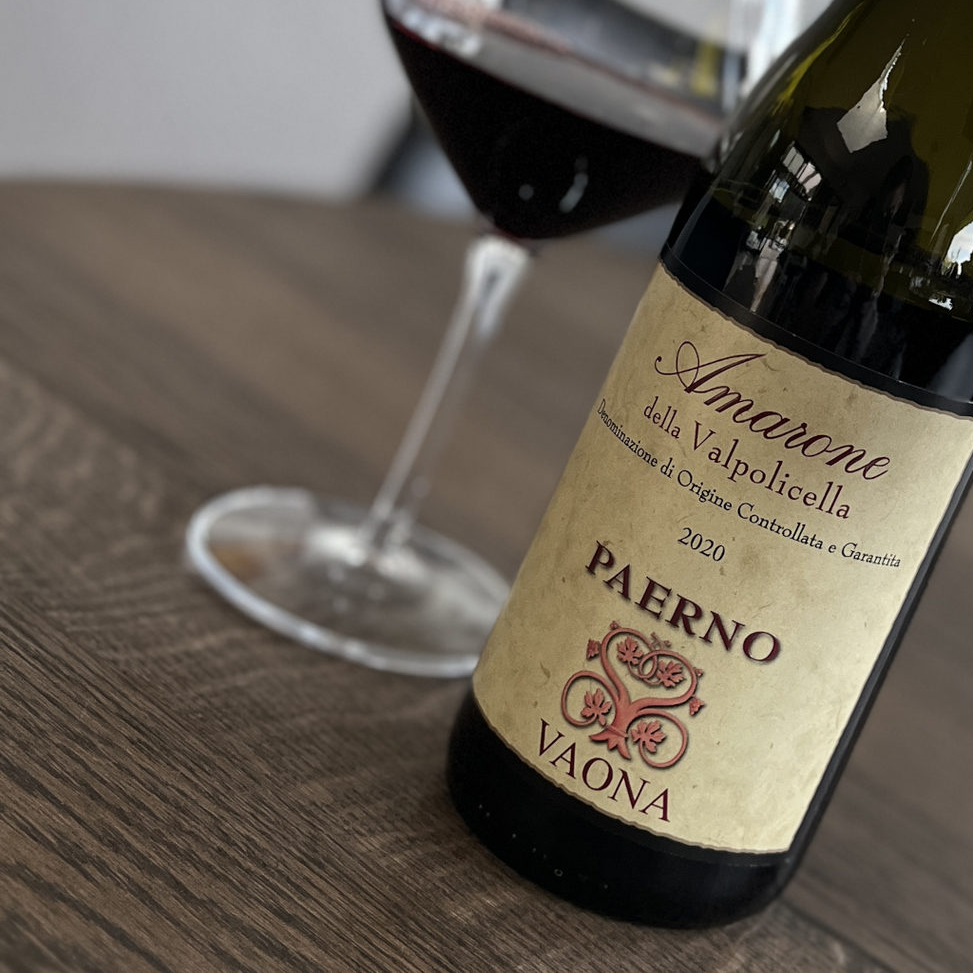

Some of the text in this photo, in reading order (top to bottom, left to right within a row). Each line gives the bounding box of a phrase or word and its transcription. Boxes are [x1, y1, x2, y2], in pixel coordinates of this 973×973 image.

[643, 396, 851, 520] della Valpolicella
[654, 340, 891, 480] Amarone
[597, 398, 658, 467] Denominazione
[660, 457, 674, 479] di
[677, 469, 733, 511] Origine
[737, 502, 823, 550] Controllata
[828, 542, 837, 554] e
[585, 540, 781, 664] PAERNO
[677, 526, 726, 563] 2020
[537, 718, 671, 823] VAONA
